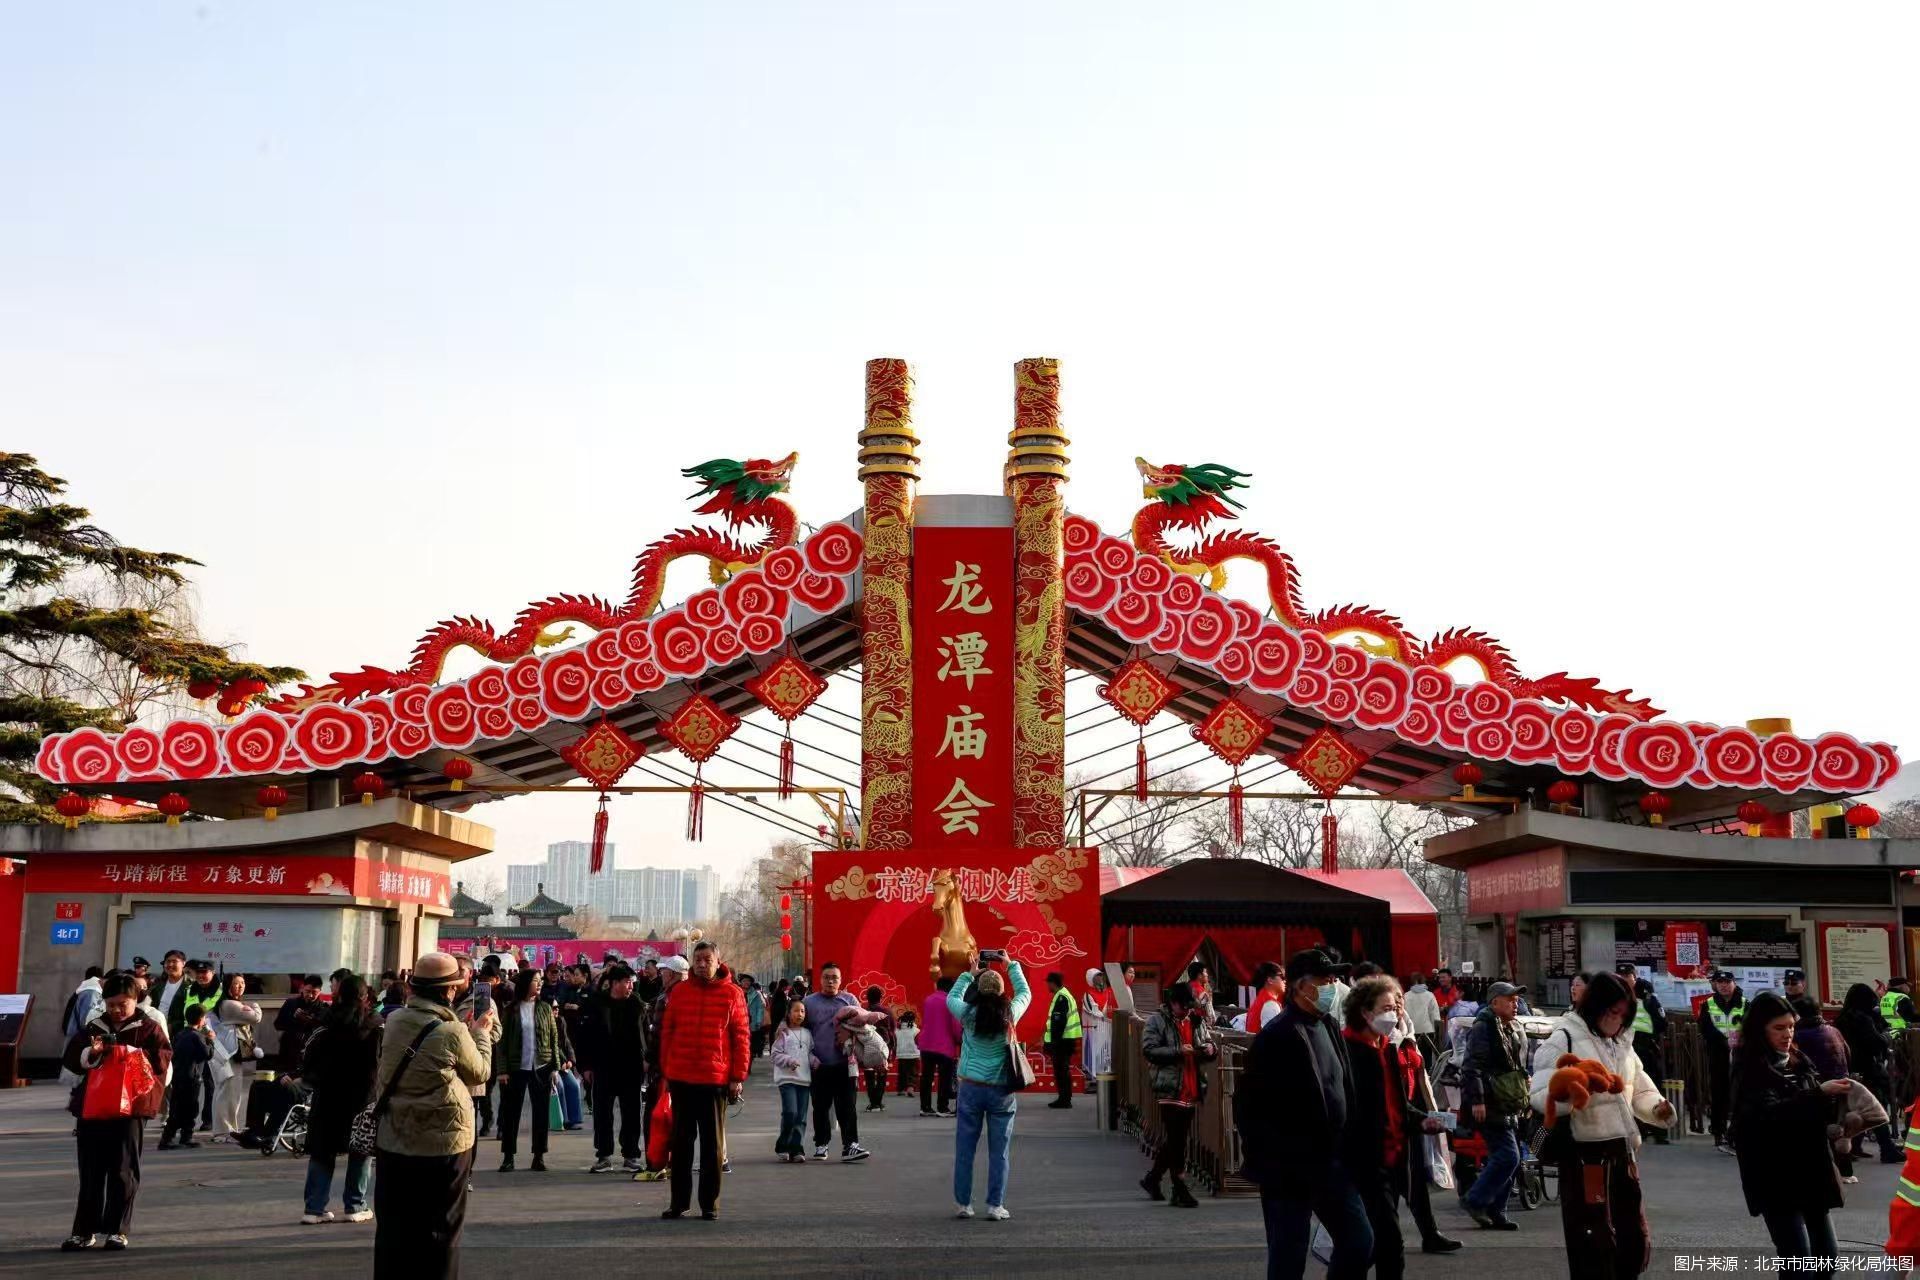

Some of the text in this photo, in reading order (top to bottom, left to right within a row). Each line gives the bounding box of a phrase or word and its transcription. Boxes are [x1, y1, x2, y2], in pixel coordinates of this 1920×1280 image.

[772, 673, 806, 704] 福
[932, 560, 996, 836] 龙潭庙会
[1120, 677, 1155, 708] 福
[681, 713, 716, 745] 福
[1215, 716, 1250, 748] 福
[586, 738, 622, 770] 福
[1310, 746, 1345, 778] 福
[102, 863, 287, 885] 马踏新程 万象更新
[876, 867, 1036, 903] 京韵烟火集
[57, 928, 79, 939] 北门
[203, 921, 244, 933] 售票处
